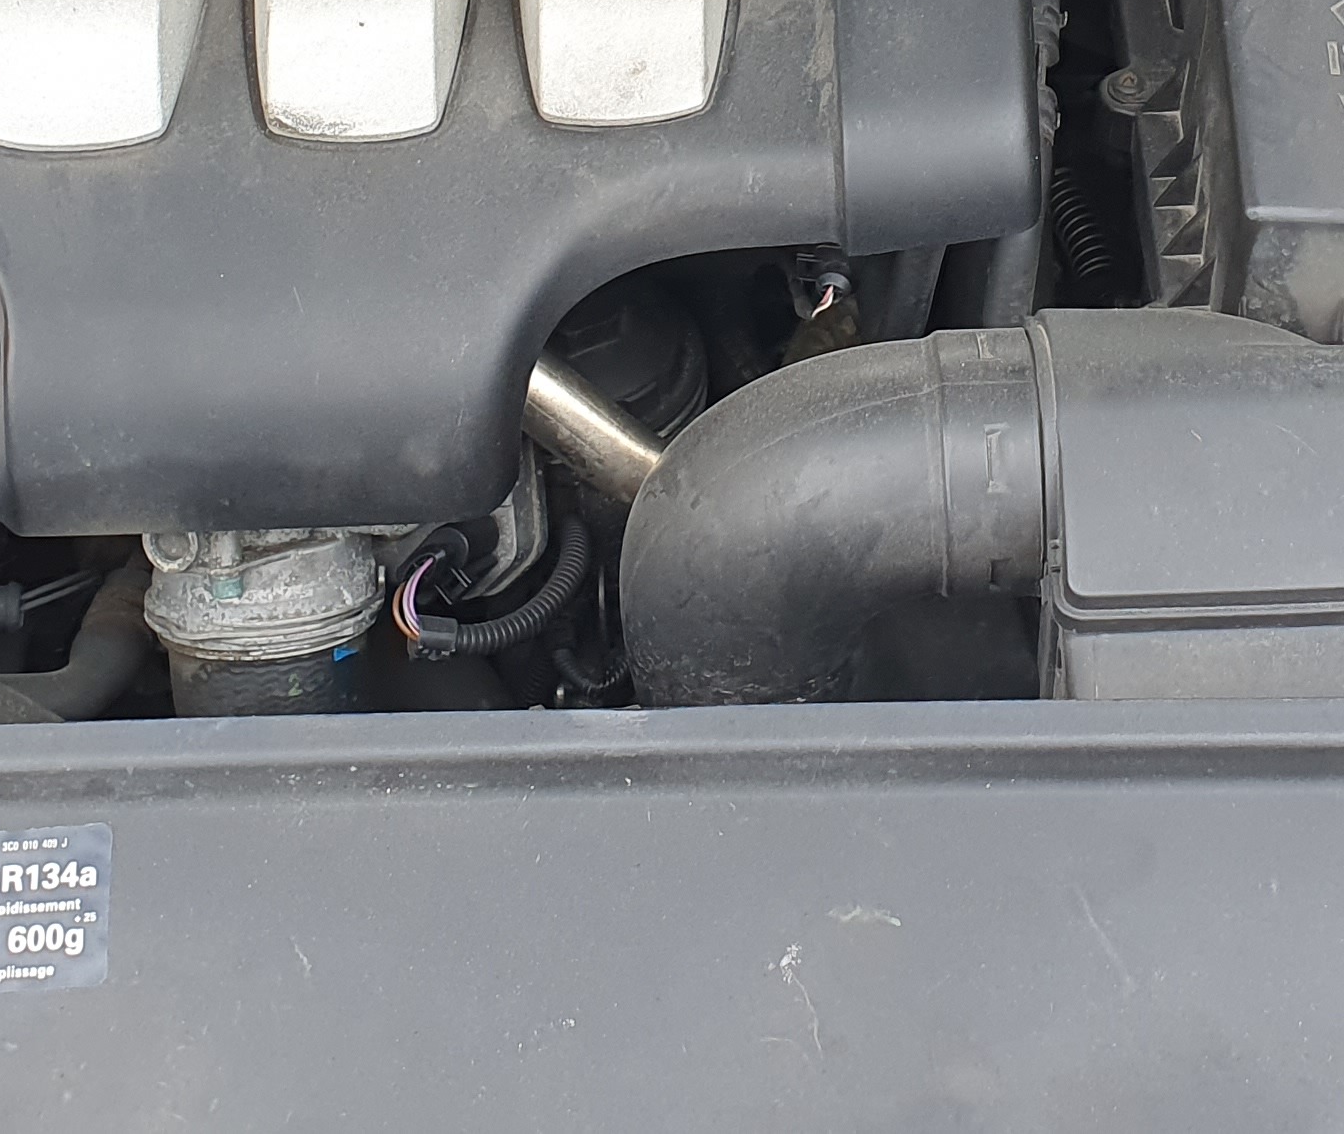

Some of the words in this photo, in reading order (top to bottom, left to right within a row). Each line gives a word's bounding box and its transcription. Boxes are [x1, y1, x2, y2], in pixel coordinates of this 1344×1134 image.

[23, 840, 38, 851] 010
[42, 839, 57, 849] 409
[62, 838, 69, 848] J
[2, 862, 97, 892] R134a
[8, 923, 84, 955] 600g
